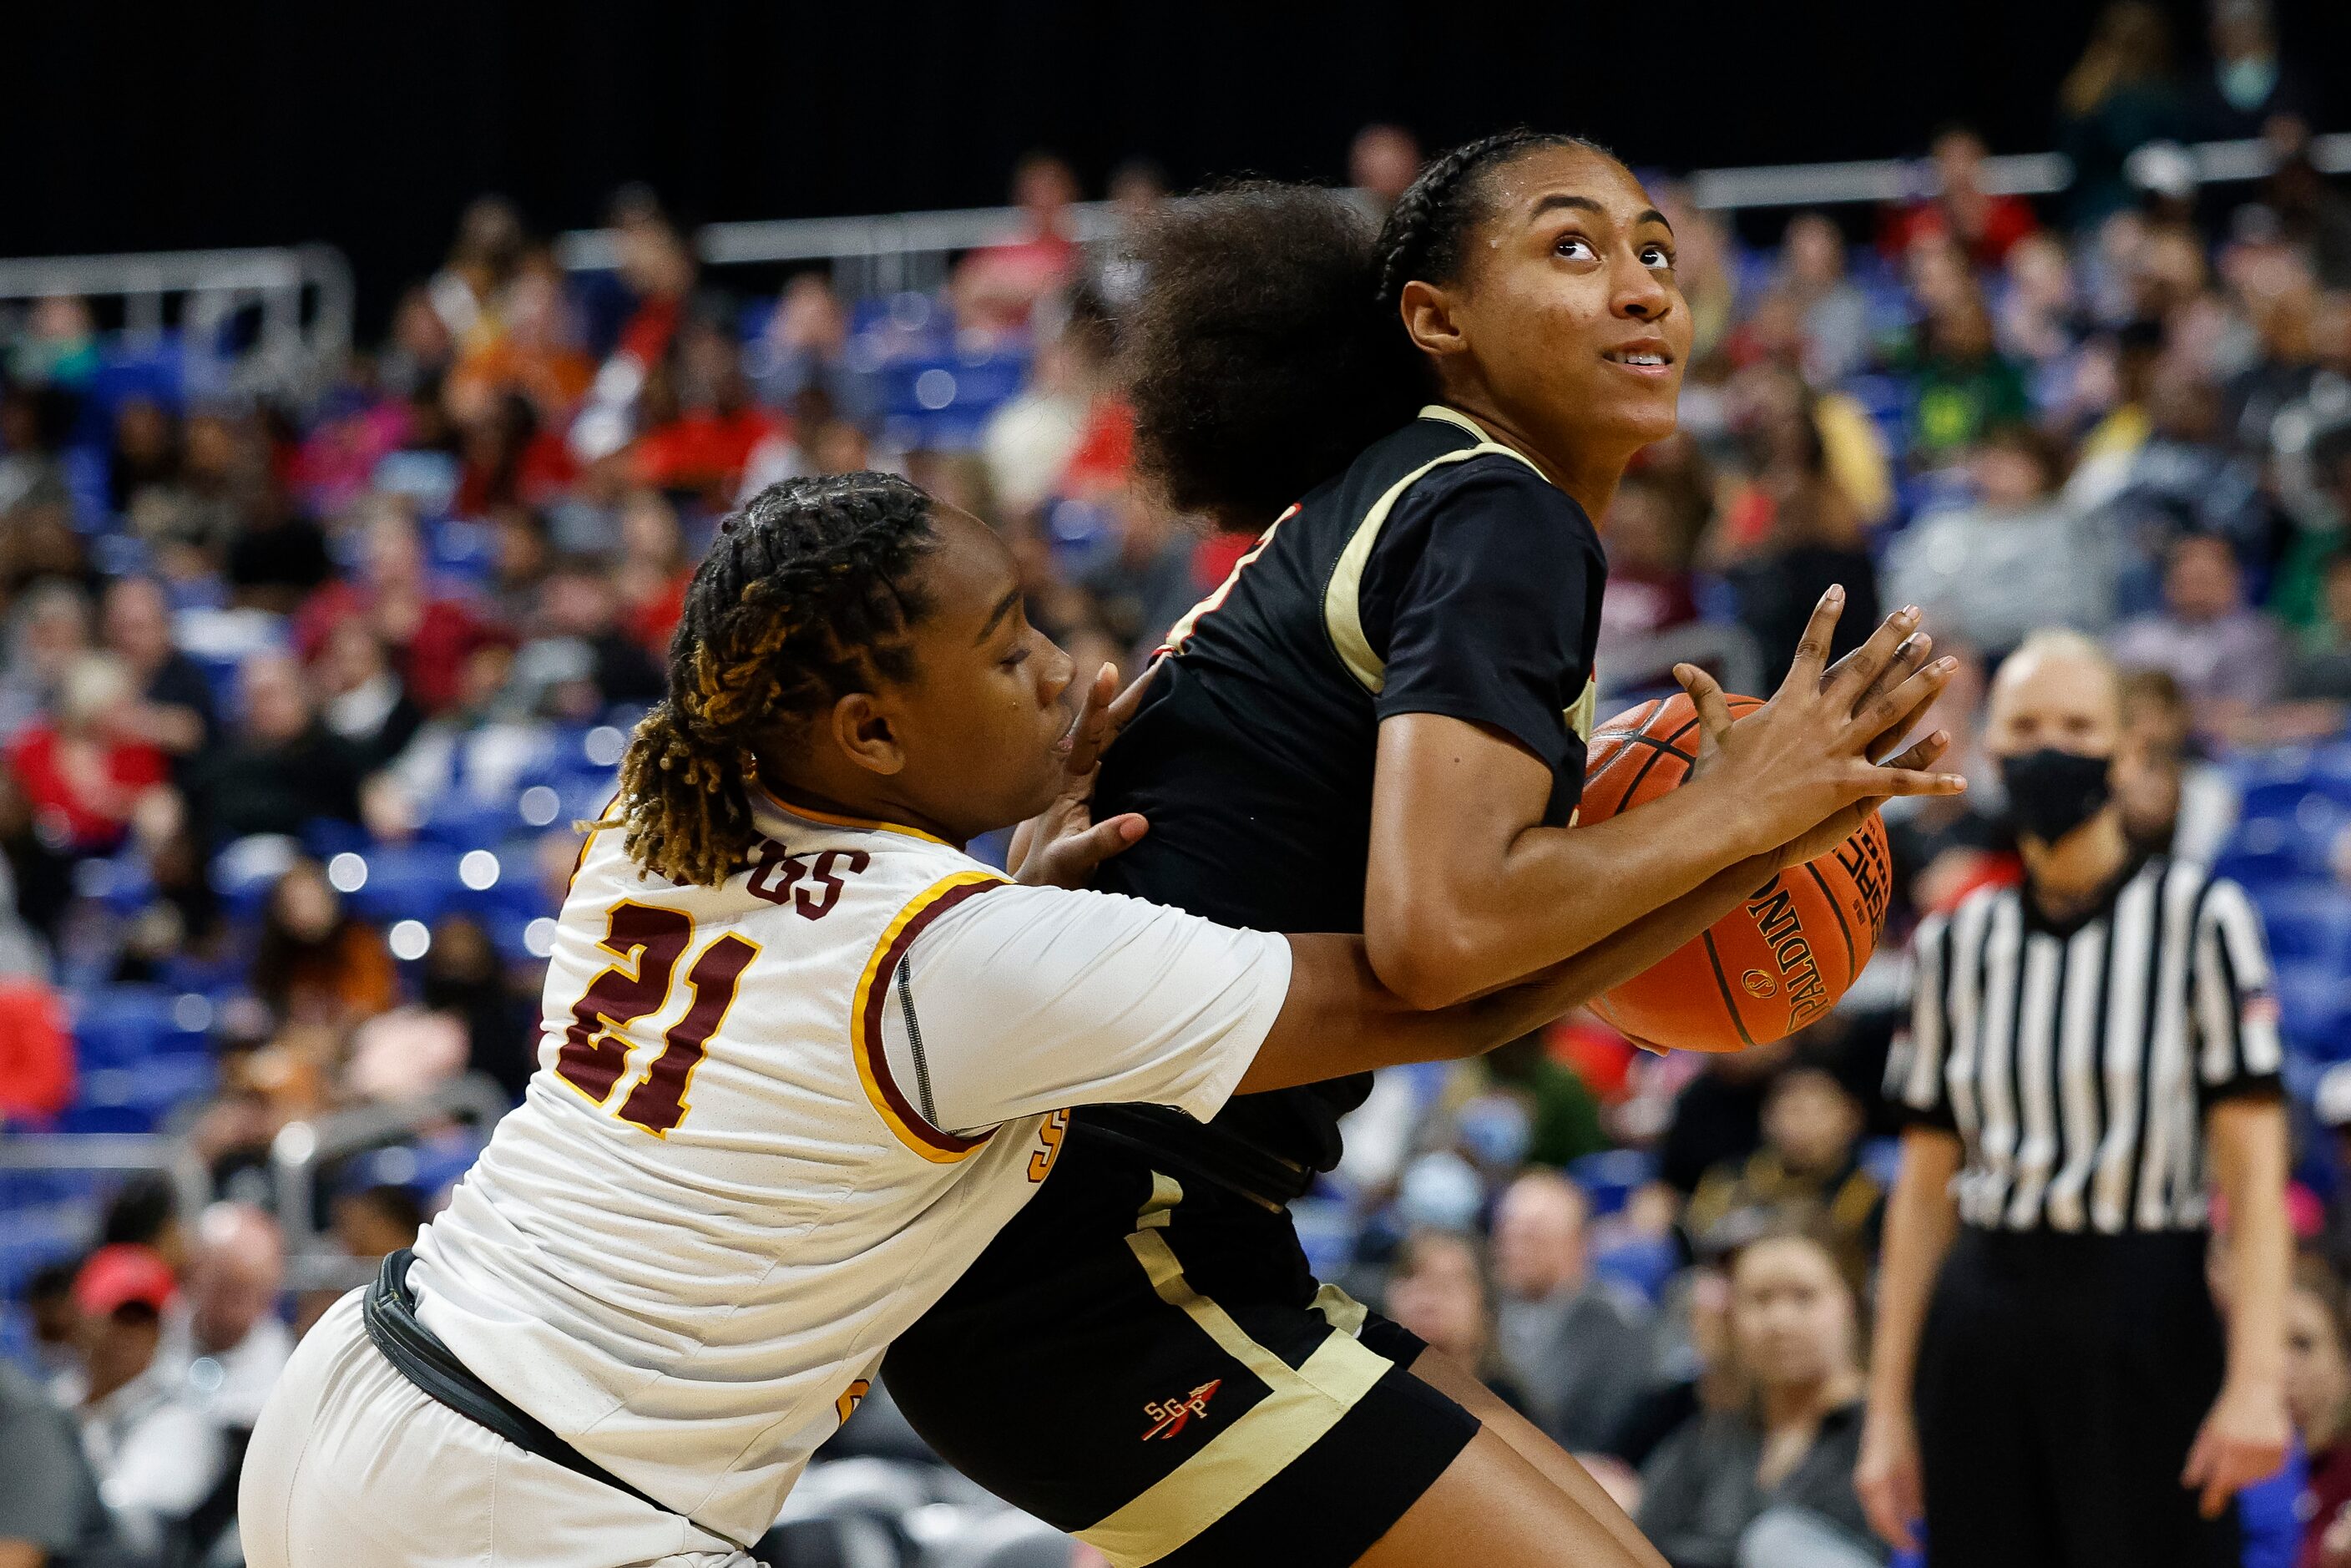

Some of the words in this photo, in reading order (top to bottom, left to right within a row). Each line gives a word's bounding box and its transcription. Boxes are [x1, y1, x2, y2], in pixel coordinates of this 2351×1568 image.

[1747, 871, 1831, 1035] PALDIN
[554, 898, 763, 1141] 21
[1027, 1108, 1070, 1183] S
[1144, 1398, 1208, 1422] SGP
